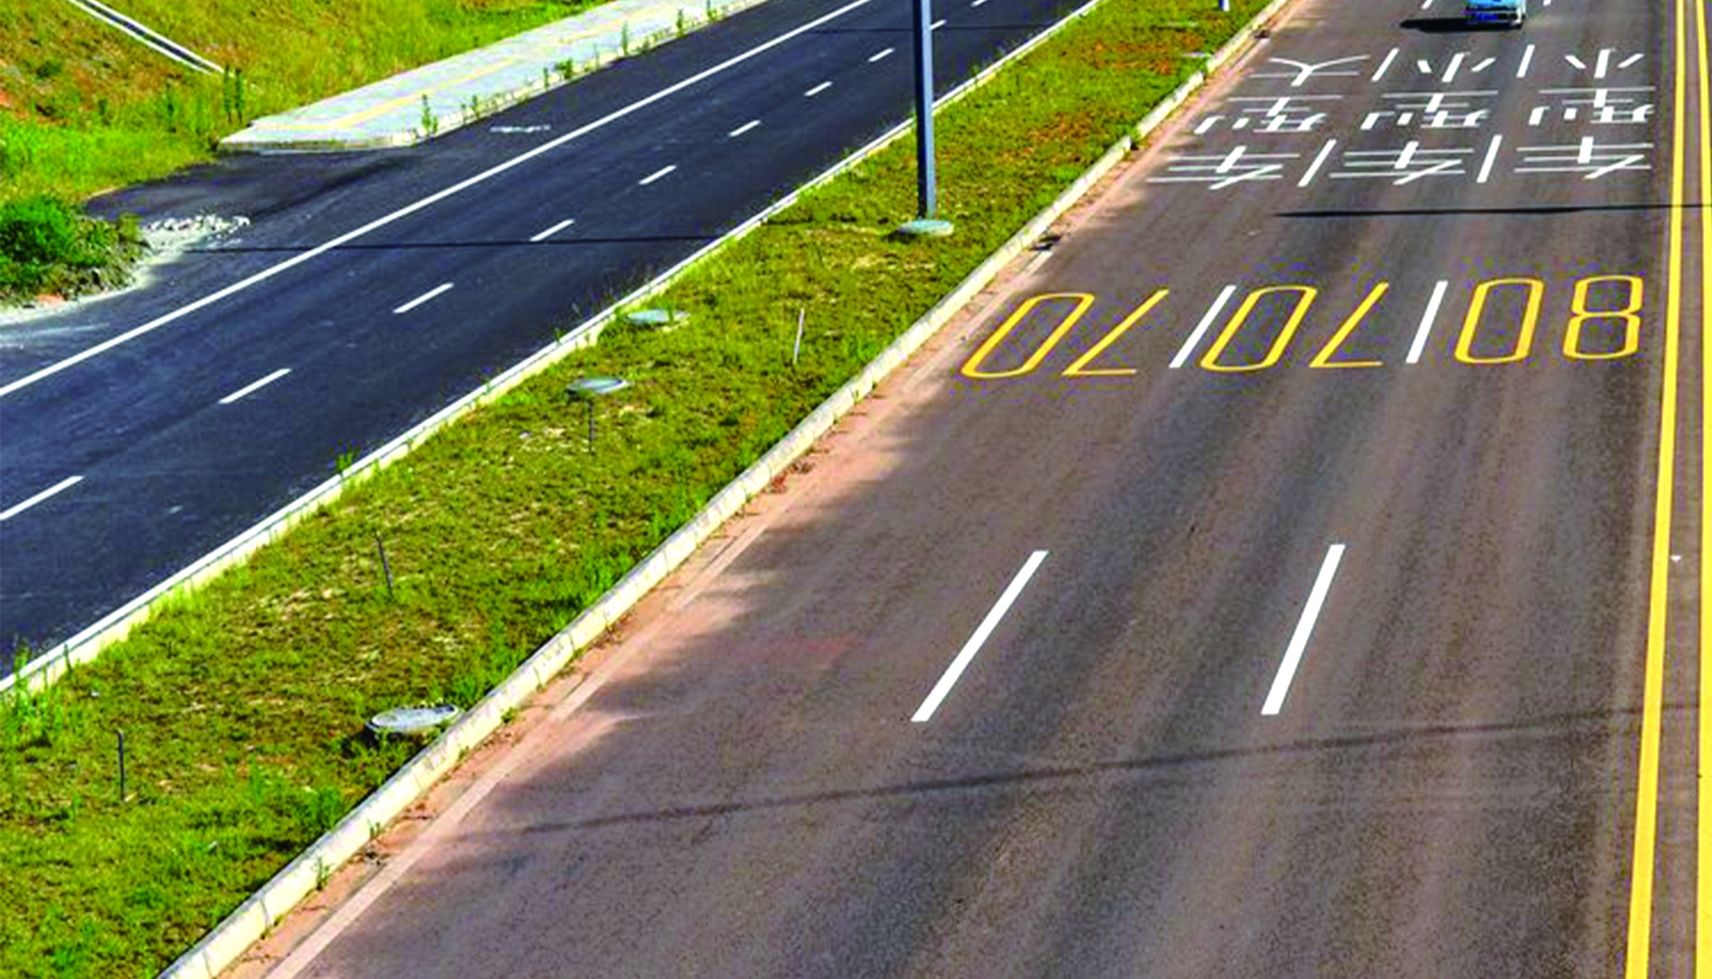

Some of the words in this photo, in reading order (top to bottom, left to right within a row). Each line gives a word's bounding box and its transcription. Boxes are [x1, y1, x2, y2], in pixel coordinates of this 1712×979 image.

[1329, 50, 1499, 186] 小型车
[1514, 46, 1656, 180] 小型车
[960, 288, 1170, 379] 70
[1200, 281, 1389, 372] 70
[1453, 273, 1644, 365] 80
